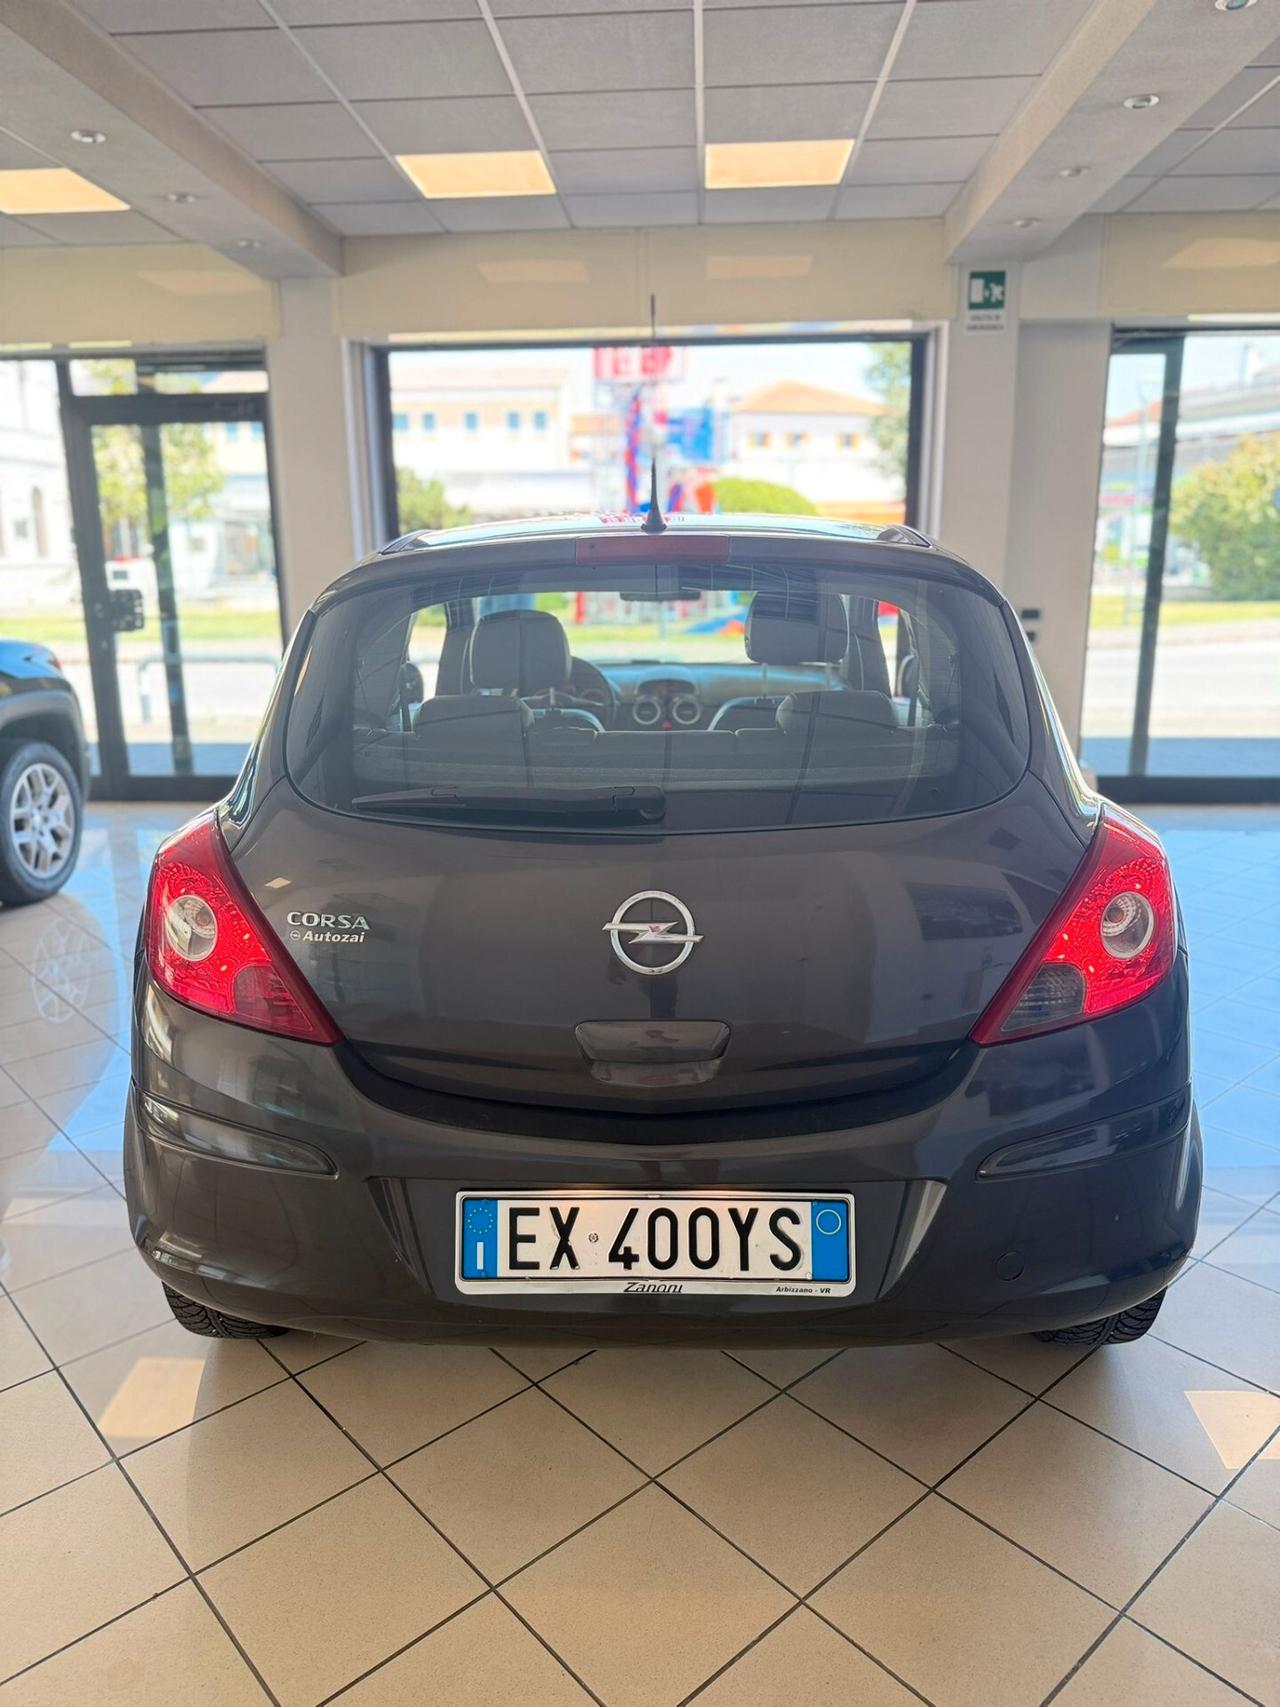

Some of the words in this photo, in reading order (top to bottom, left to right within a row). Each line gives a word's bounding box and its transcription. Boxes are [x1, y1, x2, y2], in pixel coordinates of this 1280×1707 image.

[287, 911, 370, 930] CORSA
[302, 930, 365, 943] Autozai
[509, 1207, 580, 1270] EX
[608, 1206, 801, 1271] 400YS
[476, 1241, 484, 1270] I
